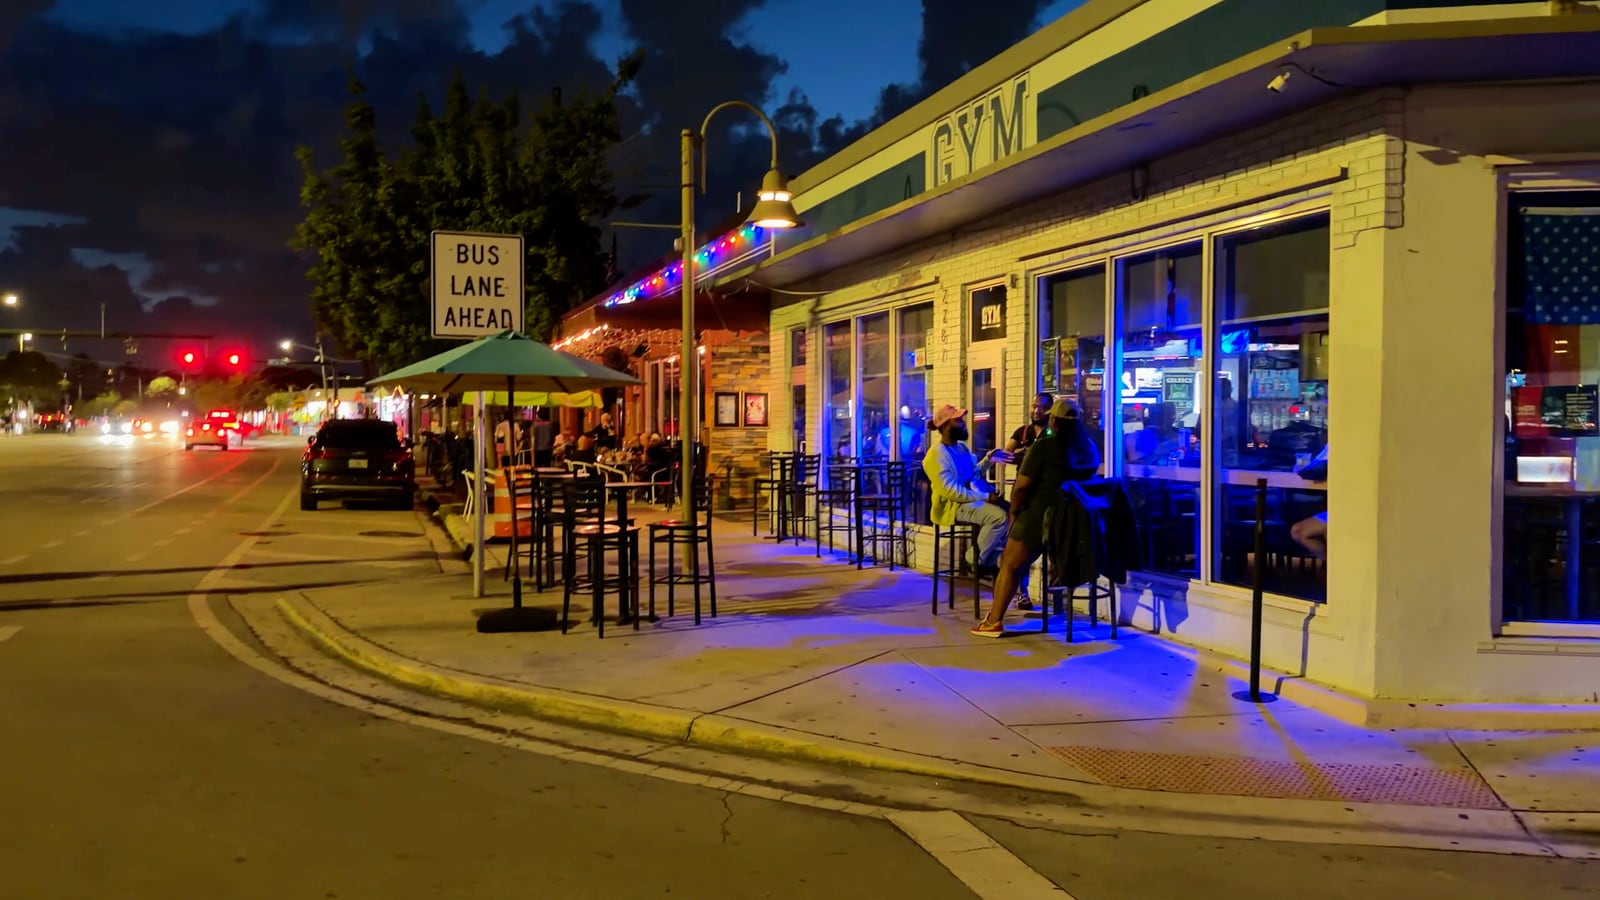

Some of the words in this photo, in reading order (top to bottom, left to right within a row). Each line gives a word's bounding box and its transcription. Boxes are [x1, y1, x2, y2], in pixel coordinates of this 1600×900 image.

[932, 71, 1030, 188] GYM
[456, 243, 500, 265] BUS
[451, 274, 505, 297] LANE
[444, 306, 514, 329] AHEAD
[981, 303, 1001, 326] GYM
